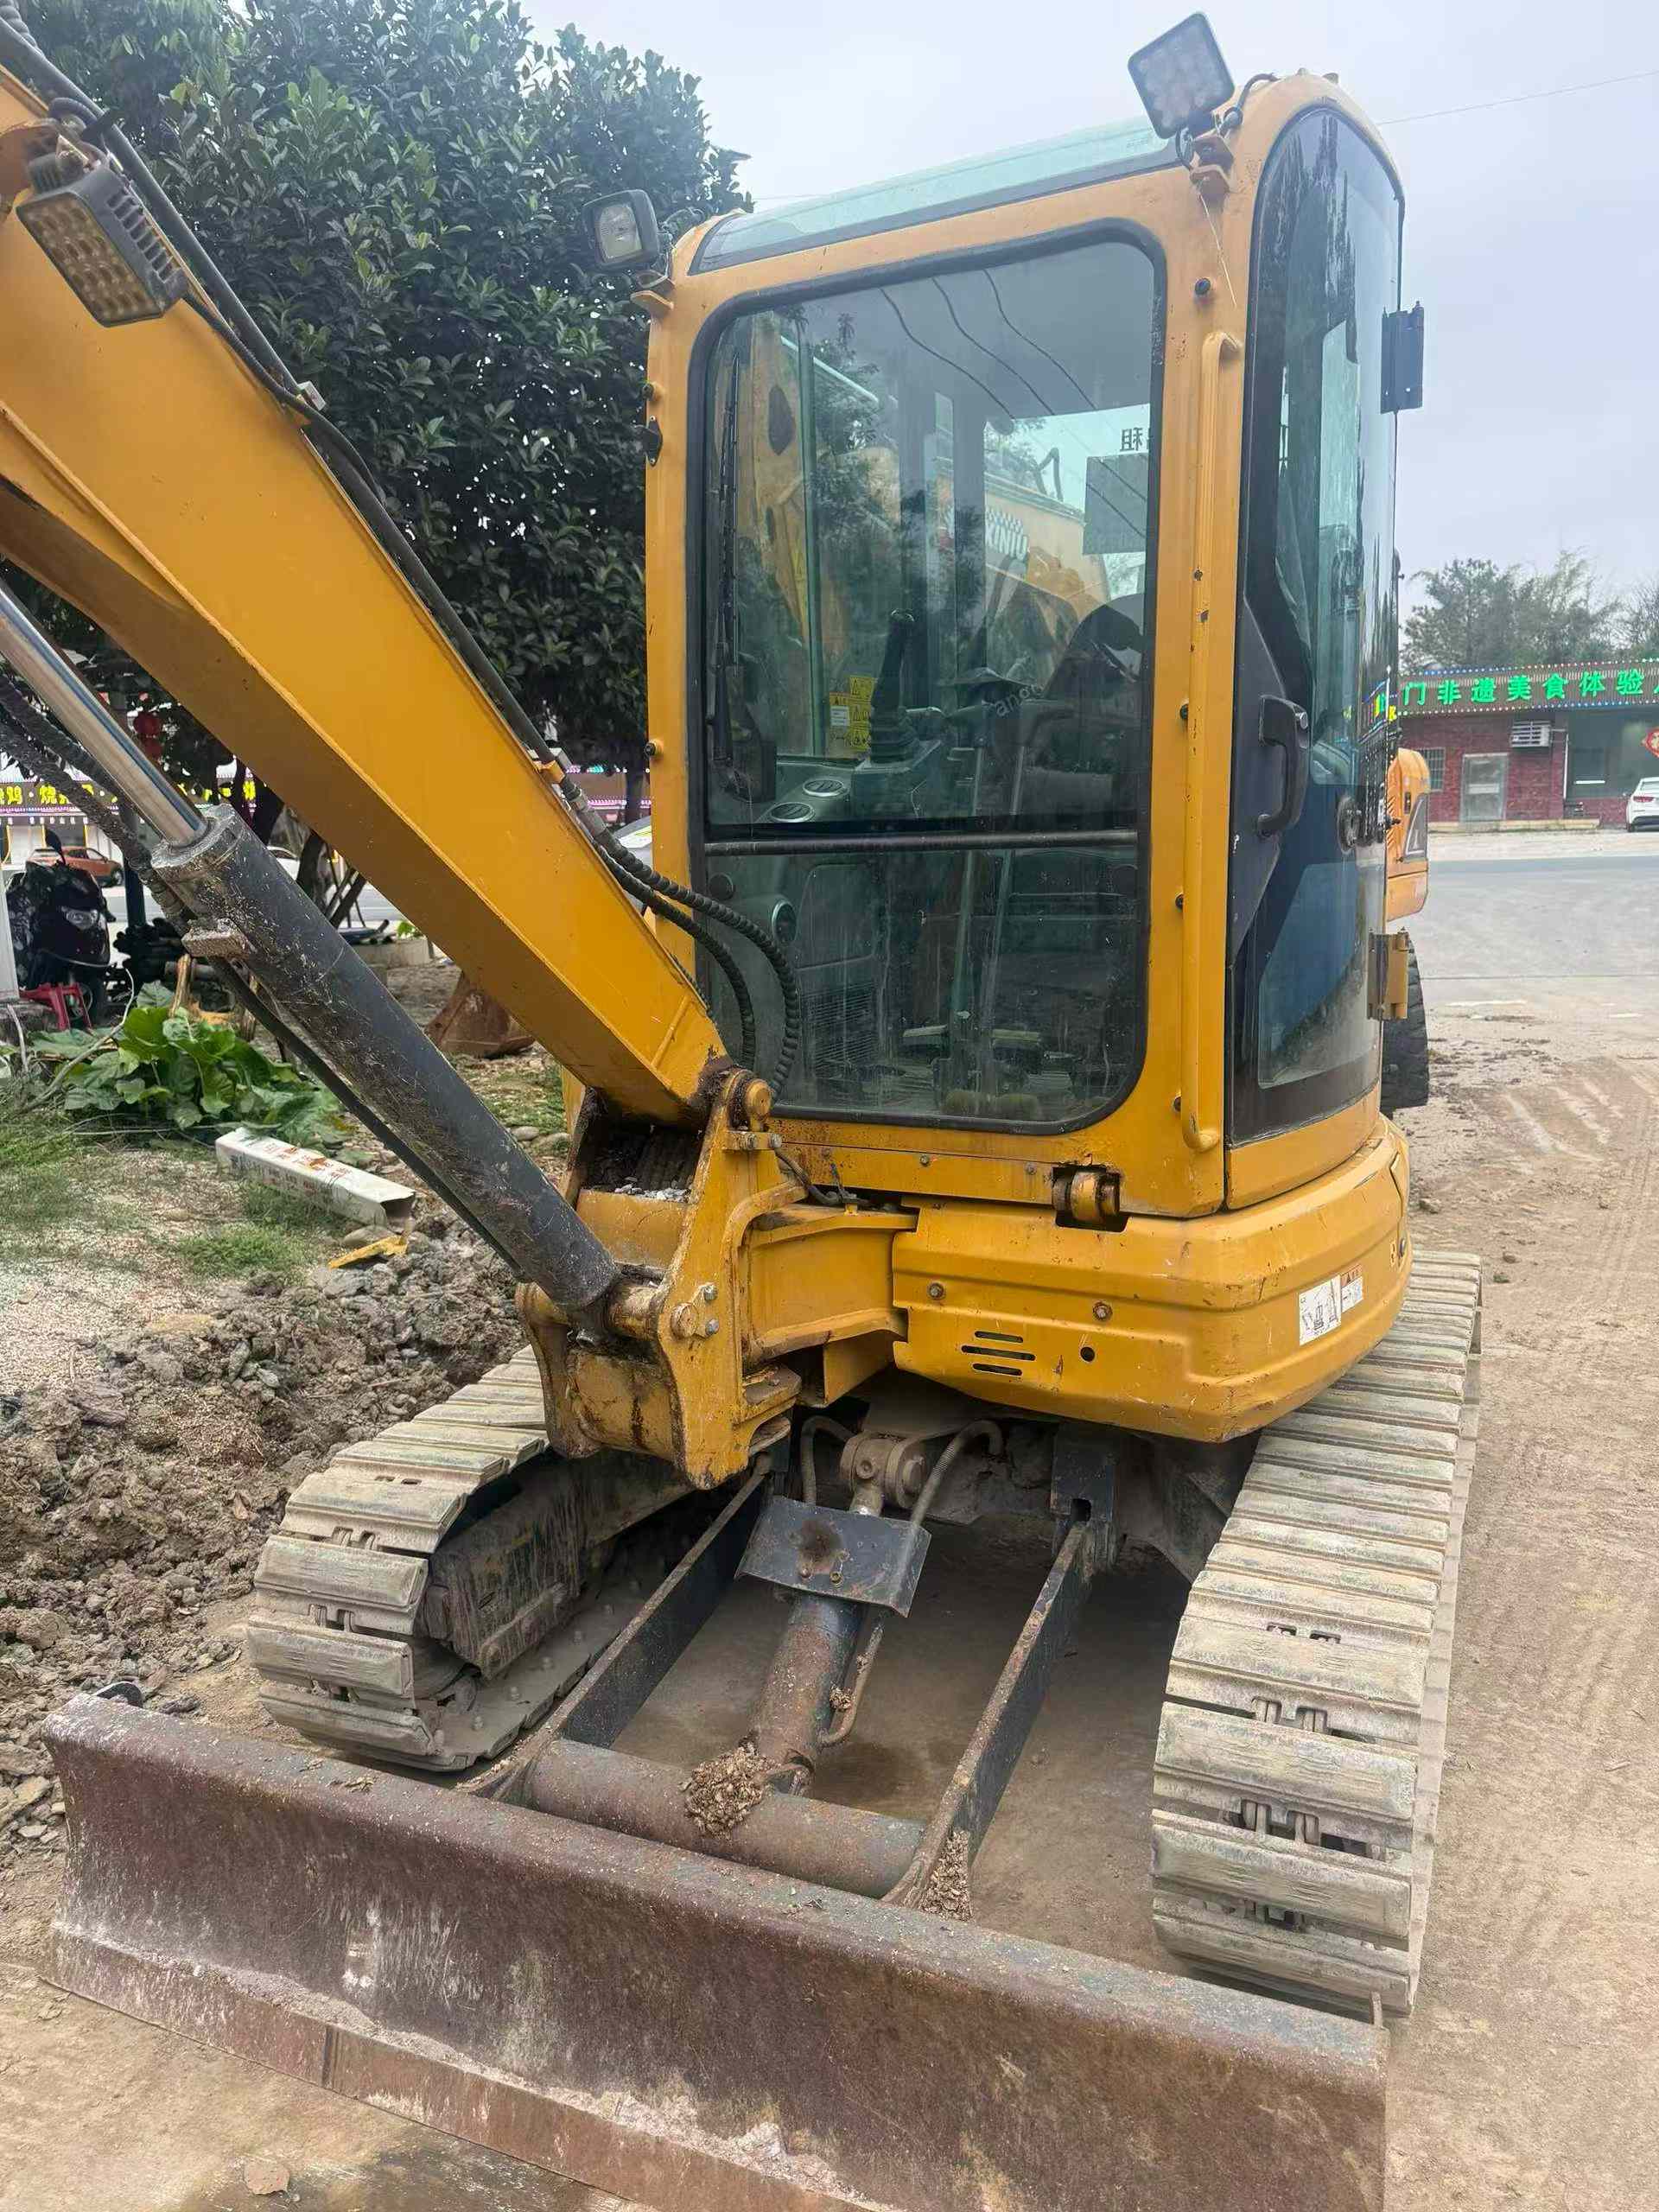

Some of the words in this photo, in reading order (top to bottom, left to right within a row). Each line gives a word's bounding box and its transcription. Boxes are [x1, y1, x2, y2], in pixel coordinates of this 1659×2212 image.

[1403, 668, 1659, 706] 门非遗美食体验
